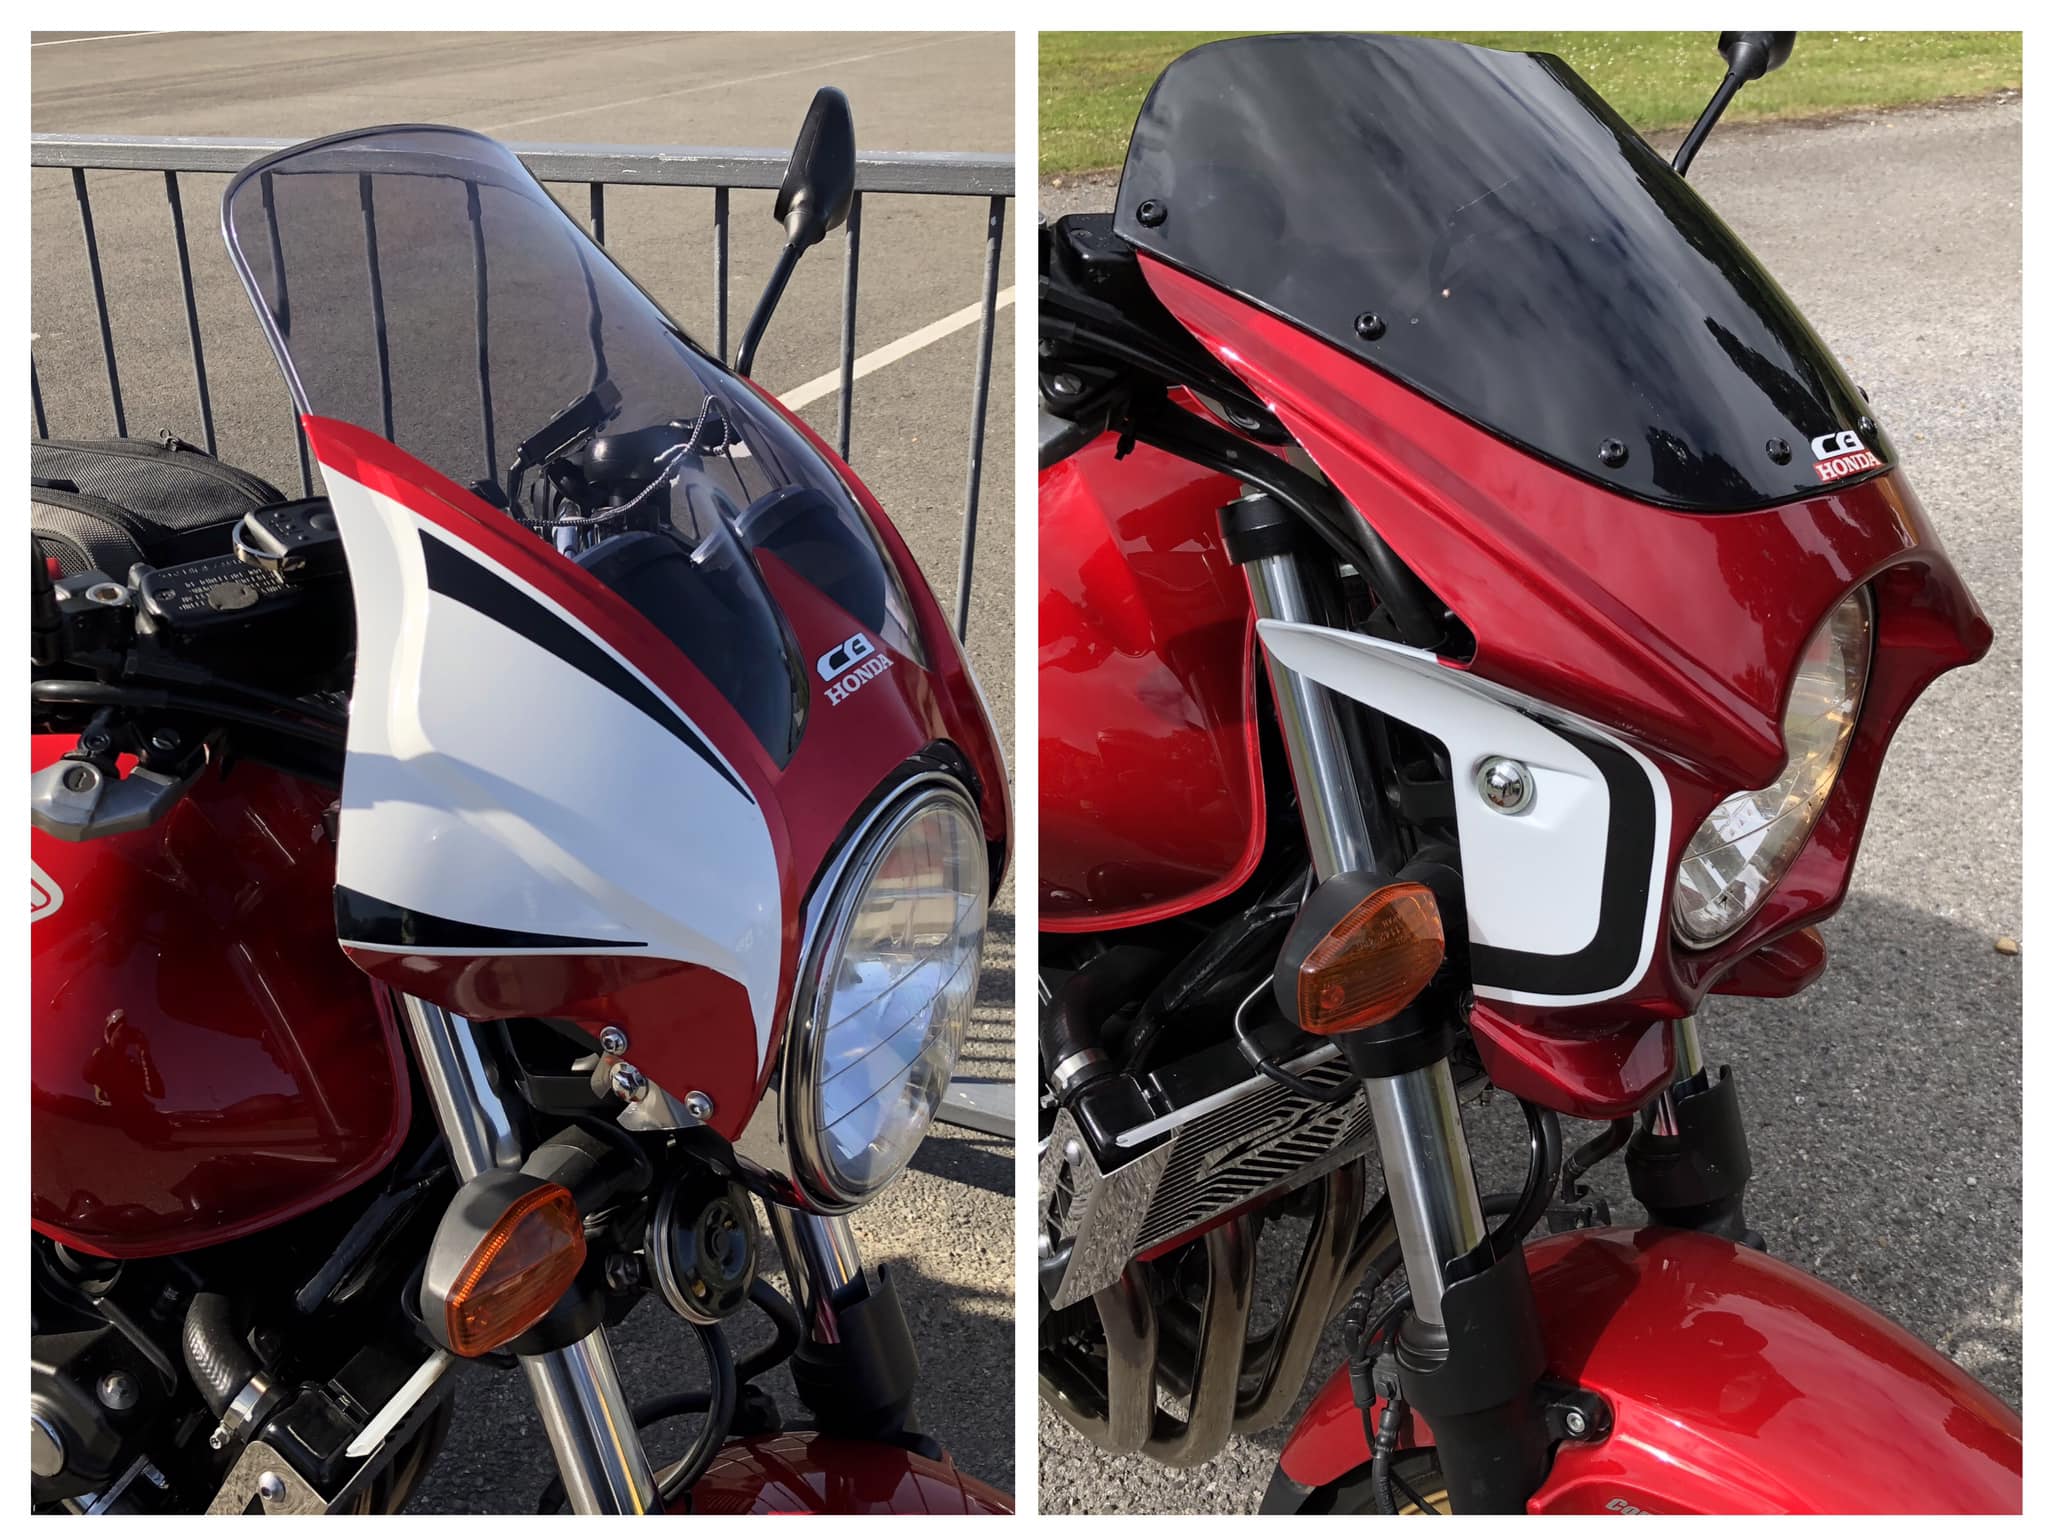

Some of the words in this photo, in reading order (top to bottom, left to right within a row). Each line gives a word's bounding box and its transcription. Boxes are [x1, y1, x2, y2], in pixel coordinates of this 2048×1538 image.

[1811, 430, 1865, 460] CB
[1815, 451, 1882, 481] HONDA
[816, 632, 876, 682] CB
[823, 653, 894, 706] HONDA
